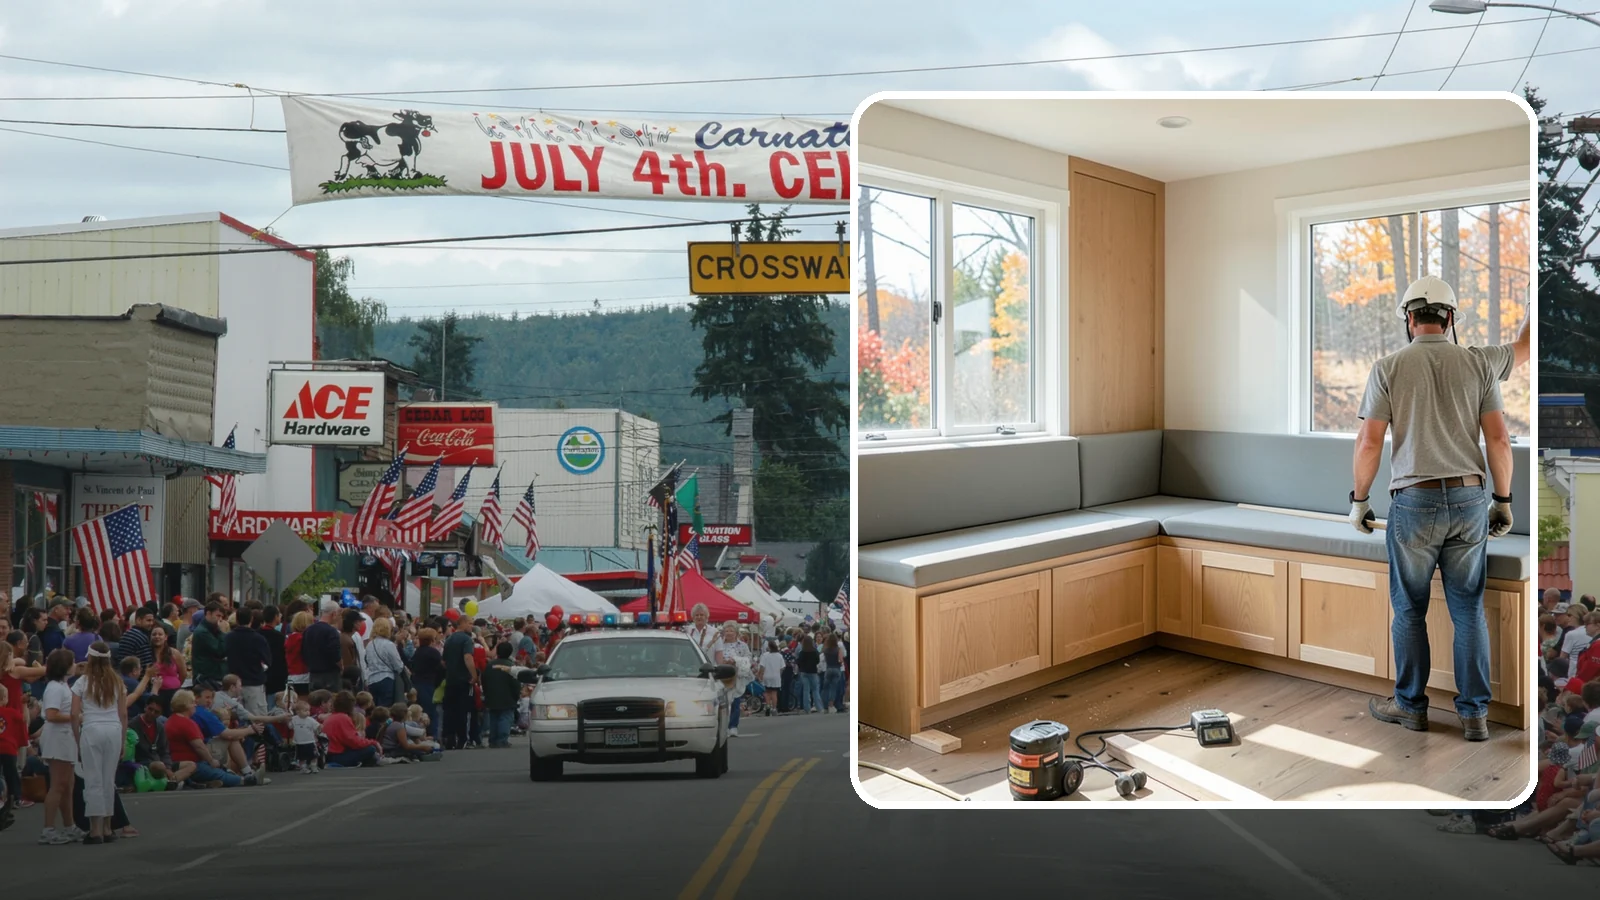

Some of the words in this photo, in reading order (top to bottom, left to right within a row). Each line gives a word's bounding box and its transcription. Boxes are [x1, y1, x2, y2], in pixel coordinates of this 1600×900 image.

[481, 141, 604, 193] JULY
[632, 150, 746, 198] 4th.
[697, 254, 850, 280] CROSSWA
[283, 380, 373, 420] ACE
[405, 409, 452, 422] CEDAR
[283, 421, 371, 437] Hardware
[416, 428, 477, 447] Coca-Cola
[353, 466, 386, 480] Simpl
[95, 484, 124, 495] Vincent
[126, 485, 136, 495] de
[137, 485, 155, 496] Paul
[212, 515, 331, 536] HARDARE
[688, 526, 741, 535] CRNATION
[699, 535, 730, 544] GLASS
